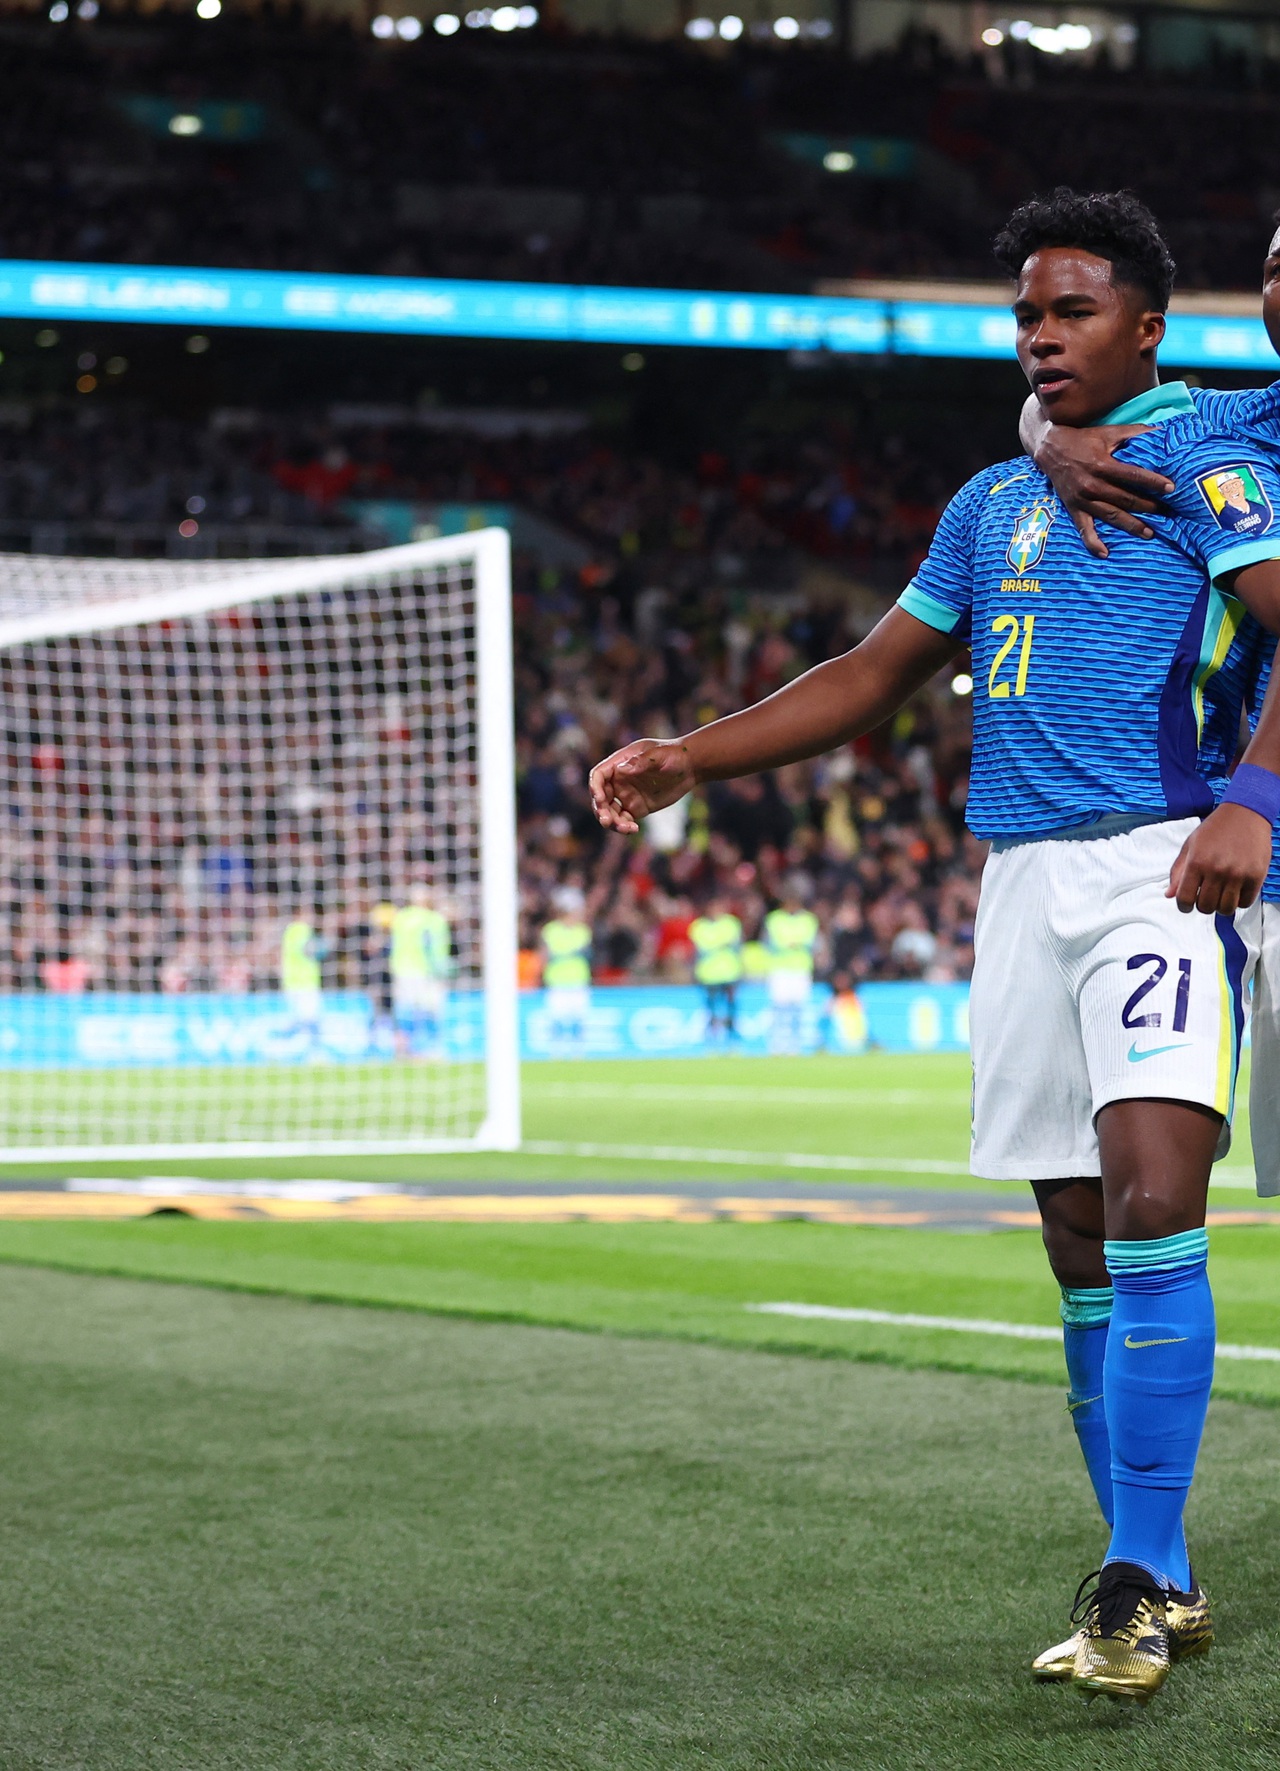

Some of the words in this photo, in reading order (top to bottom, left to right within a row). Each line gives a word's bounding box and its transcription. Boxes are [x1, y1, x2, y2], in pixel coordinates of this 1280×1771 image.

[1233, 514, 1259, 528] ZAGALLO
[1021, 532, 1037, 541] CBF
[1000, 579, 1042, 592] BRASIL
[988, 614, 1035, 698] 21
[1121, 953, 1192, 1033] 21
